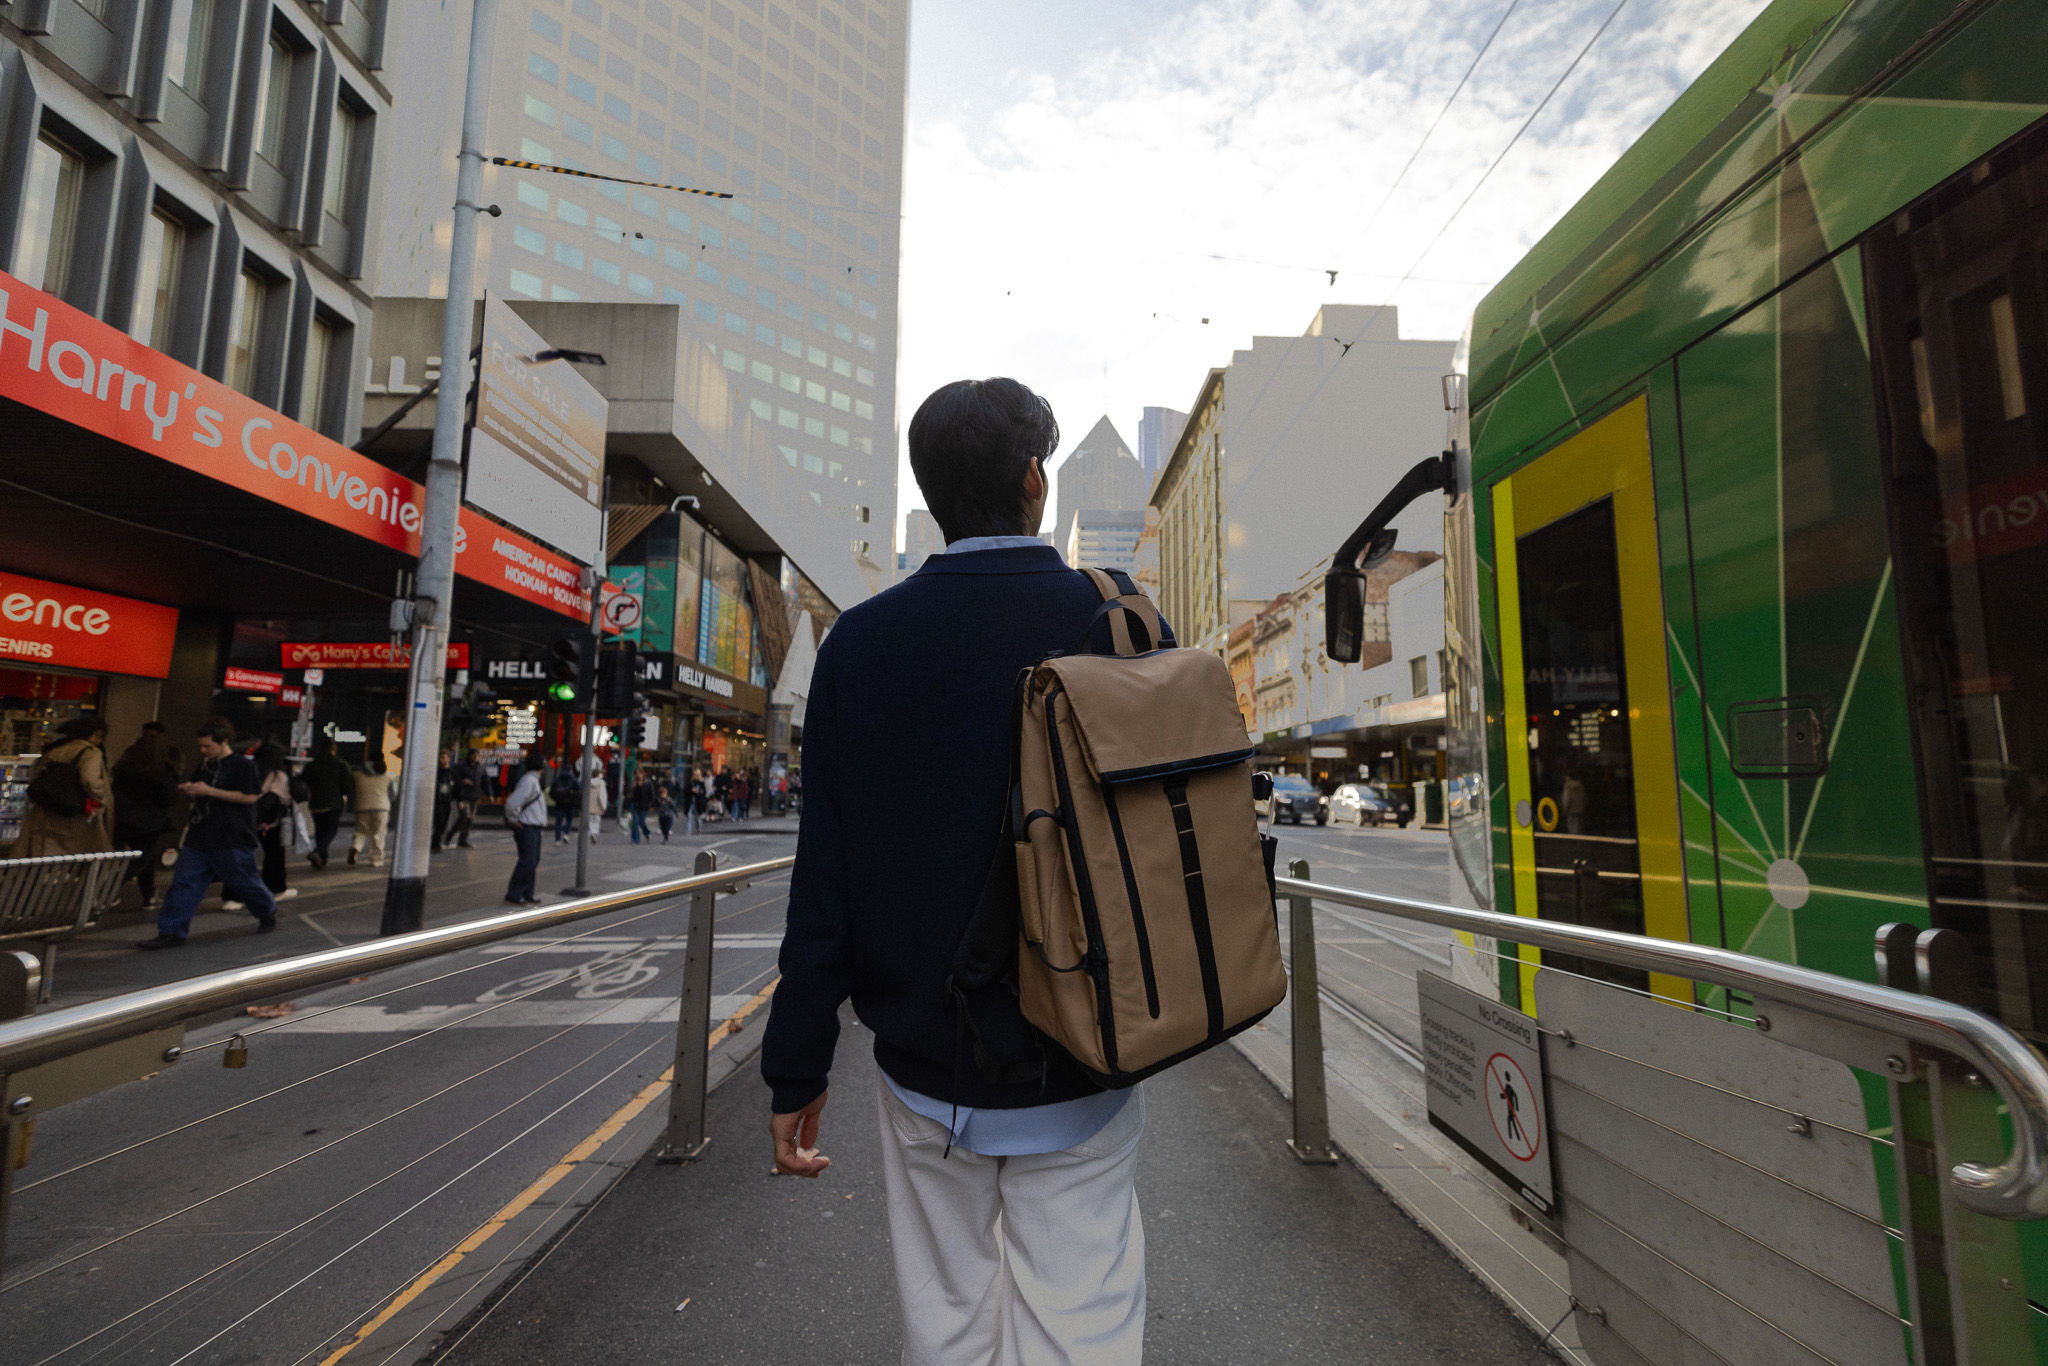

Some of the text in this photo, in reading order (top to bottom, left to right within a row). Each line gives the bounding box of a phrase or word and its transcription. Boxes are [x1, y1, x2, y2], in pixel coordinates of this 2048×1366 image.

[532, 375, 571, 425] SALE
[0, 288, 224, 448] Harry's
[241, 417, 467, 554] Conveniee
[492, 537, 578, 588] AMERICAN CANDY
[505, 565, 548, 595] HOOKAH
[323, 645, 370, 662] Harry's
[488, 660, 547, 679] HELL
[678, 664, 734, 698] HELLY HANSEN
[1478, 1003, 1532, 1045] No Crossing
